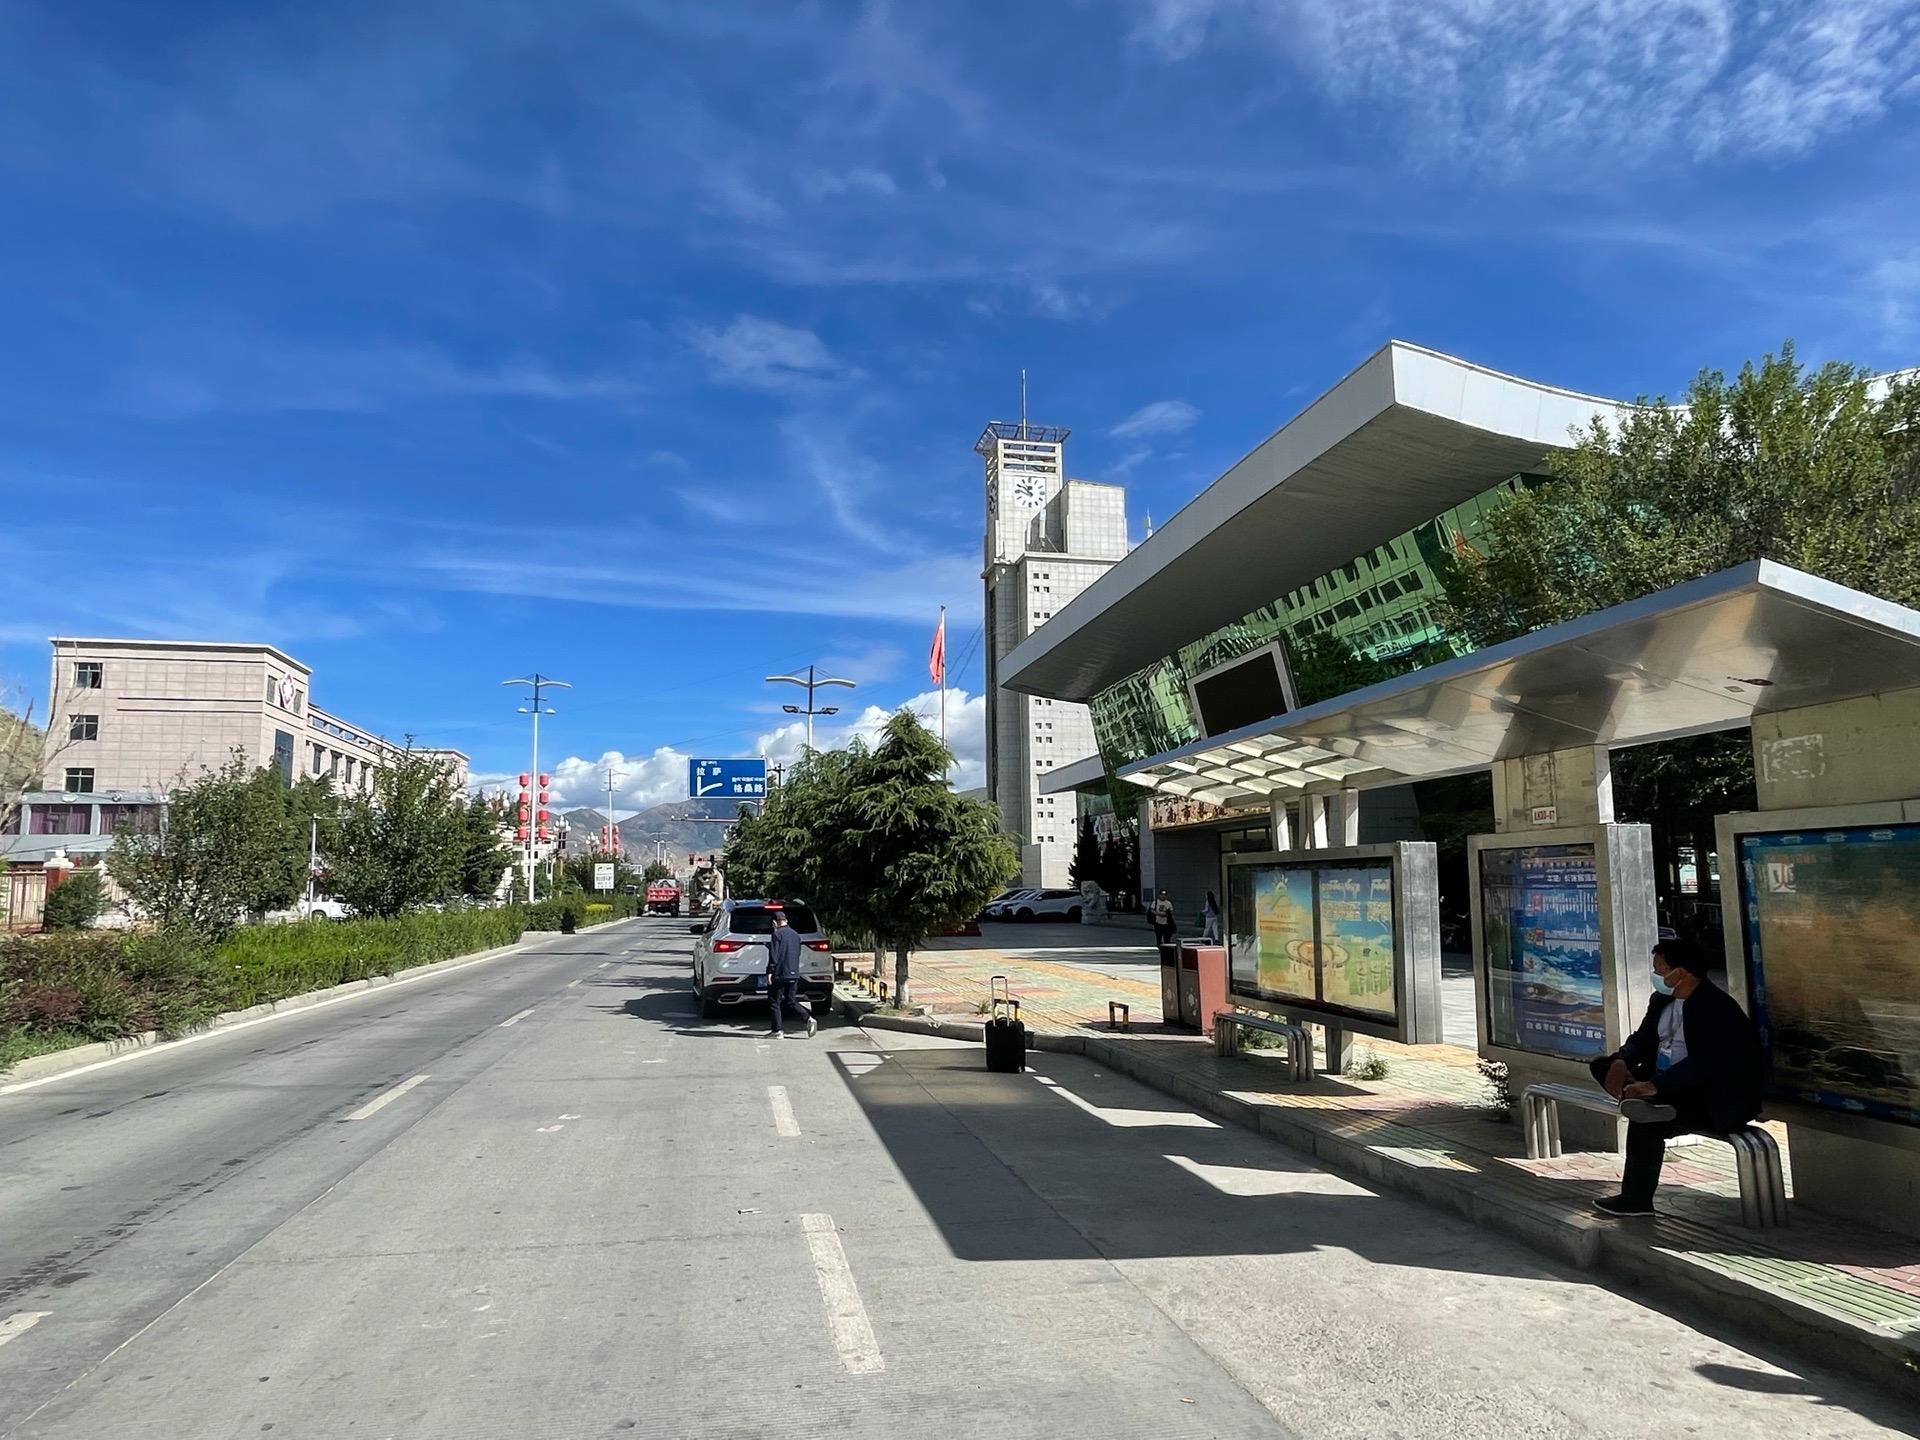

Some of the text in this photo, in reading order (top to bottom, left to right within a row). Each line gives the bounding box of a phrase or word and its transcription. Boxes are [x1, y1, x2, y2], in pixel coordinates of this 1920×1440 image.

[696, 767, 722, 777] 拉萨
[734, 784, 763, 793] 格桑路
